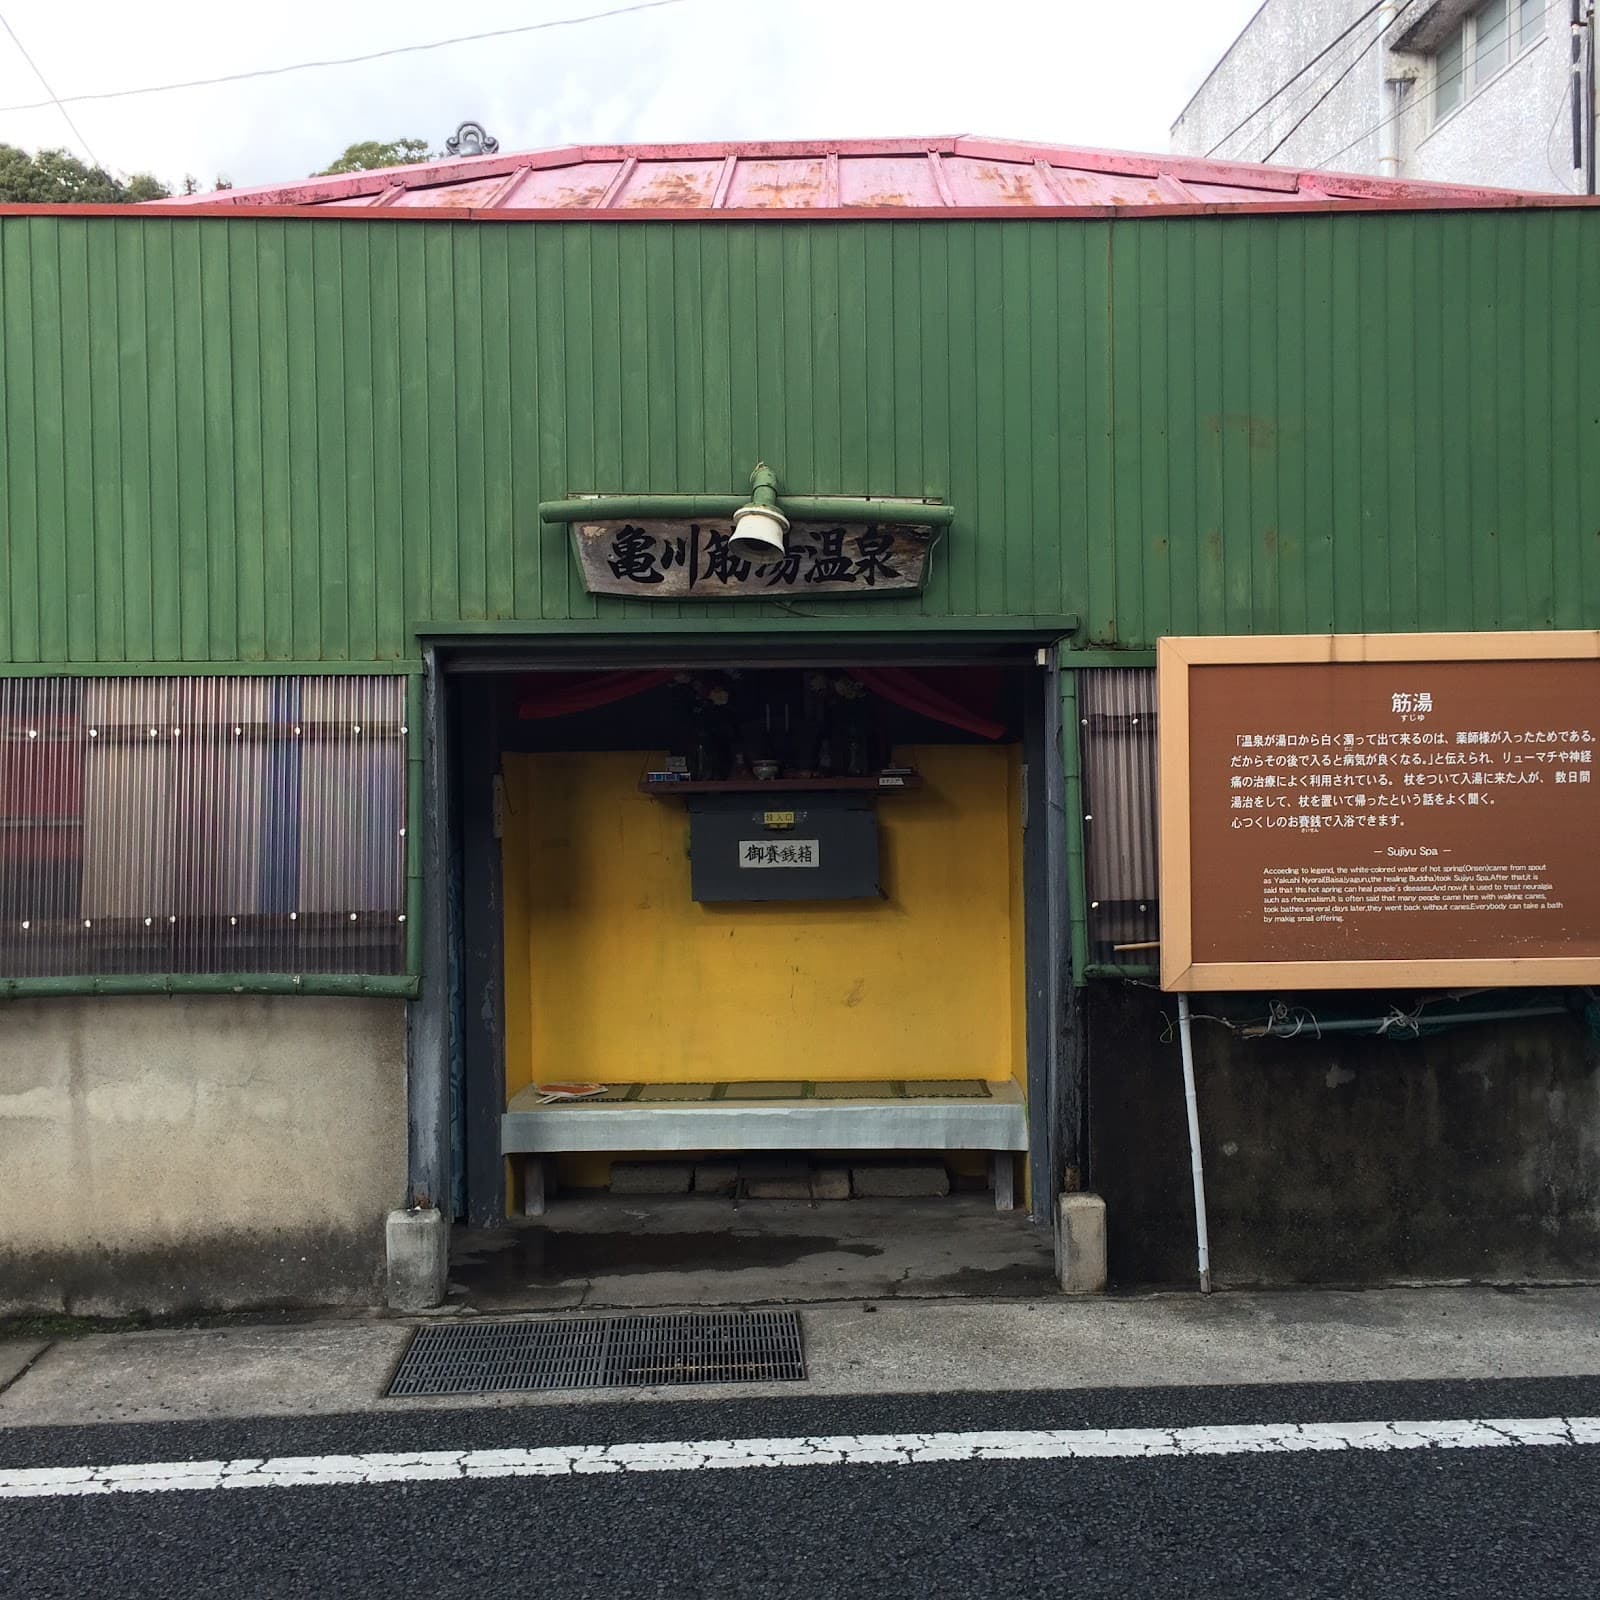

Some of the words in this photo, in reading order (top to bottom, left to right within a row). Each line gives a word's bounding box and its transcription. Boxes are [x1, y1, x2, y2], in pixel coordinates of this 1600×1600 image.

[1391, 692, 1433, 713] 筋湯
[1387, 846, 1417, 856] Sujiyu
[1419, 846, 1439, 856] Spa
[1337, 866, 1347, 874] the
[1528, 864, 1546, 872] spout
[1384, 875, 1407, 884] healing
[1454, 875, 1474, 883] Sujiyu
[1533, 873, 1538, 881] is
[1279, 886, 1293, 894] that
[1264, 896, 1279, 904] such
[1338, 895, 1343, 903] is
[1382, 894, 1395, 902] that
[1419, 894, 1440, 902] people
[1463, 893, 1479, 901] here
[1498, 893, 1523, 901] walking
[1332, 905, 1348, 913] days
[1423, 903, 1448, 911] without
[1547, 901, 1563, 909] bath
[1264, 915, 1272, 924] by
